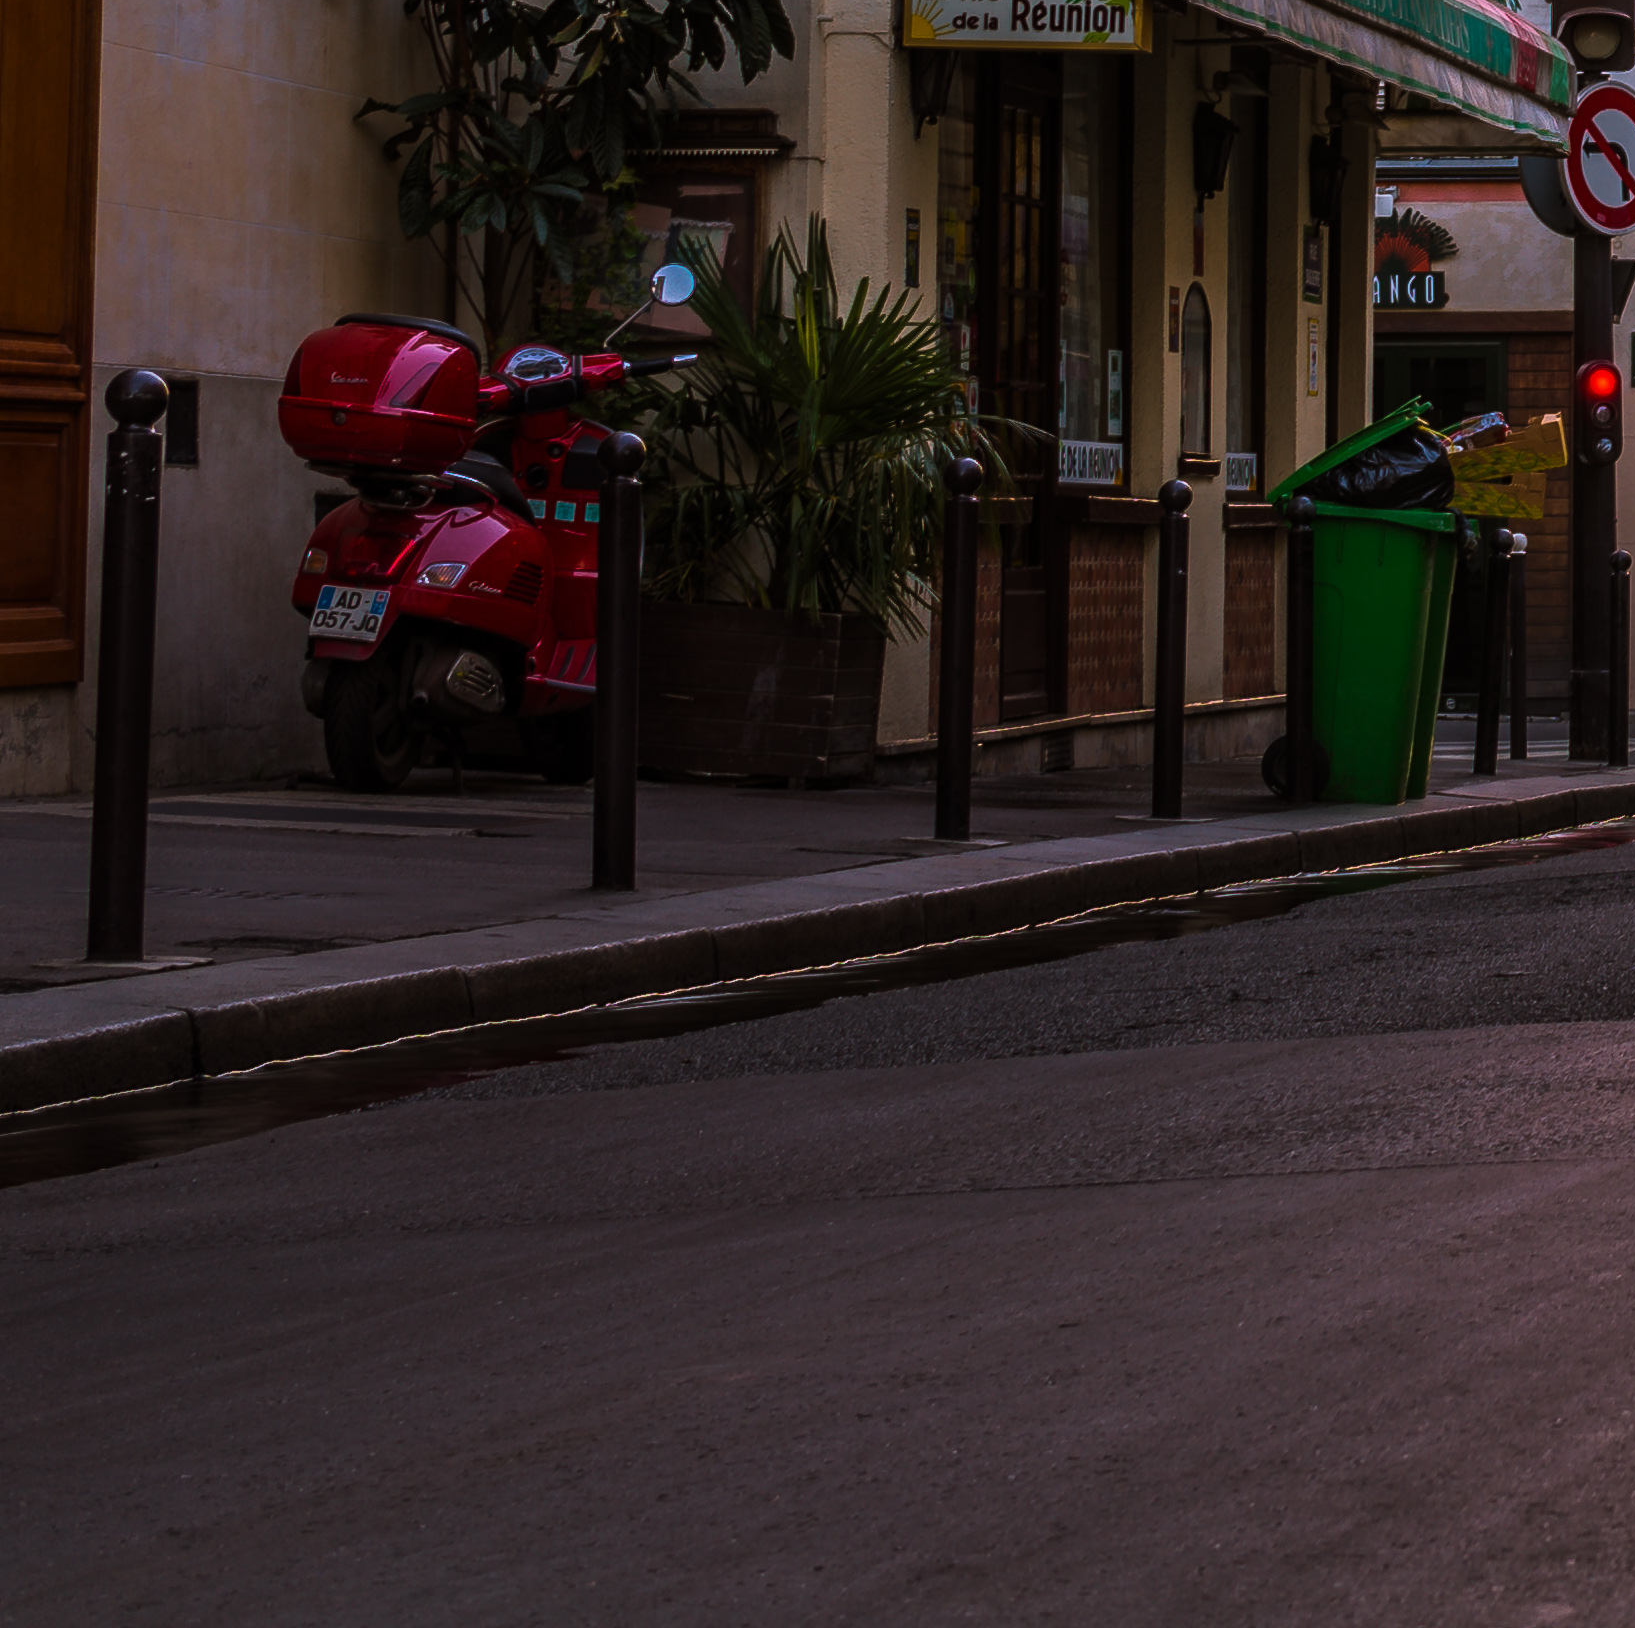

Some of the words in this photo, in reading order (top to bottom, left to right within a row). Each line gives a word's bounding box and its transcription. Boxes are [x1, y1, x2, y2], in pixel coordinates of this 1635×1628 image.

[952, 12, 979, 30] de
[983, 12, 999, 30] la
[313, 610, 380, 634] 057-JQ
